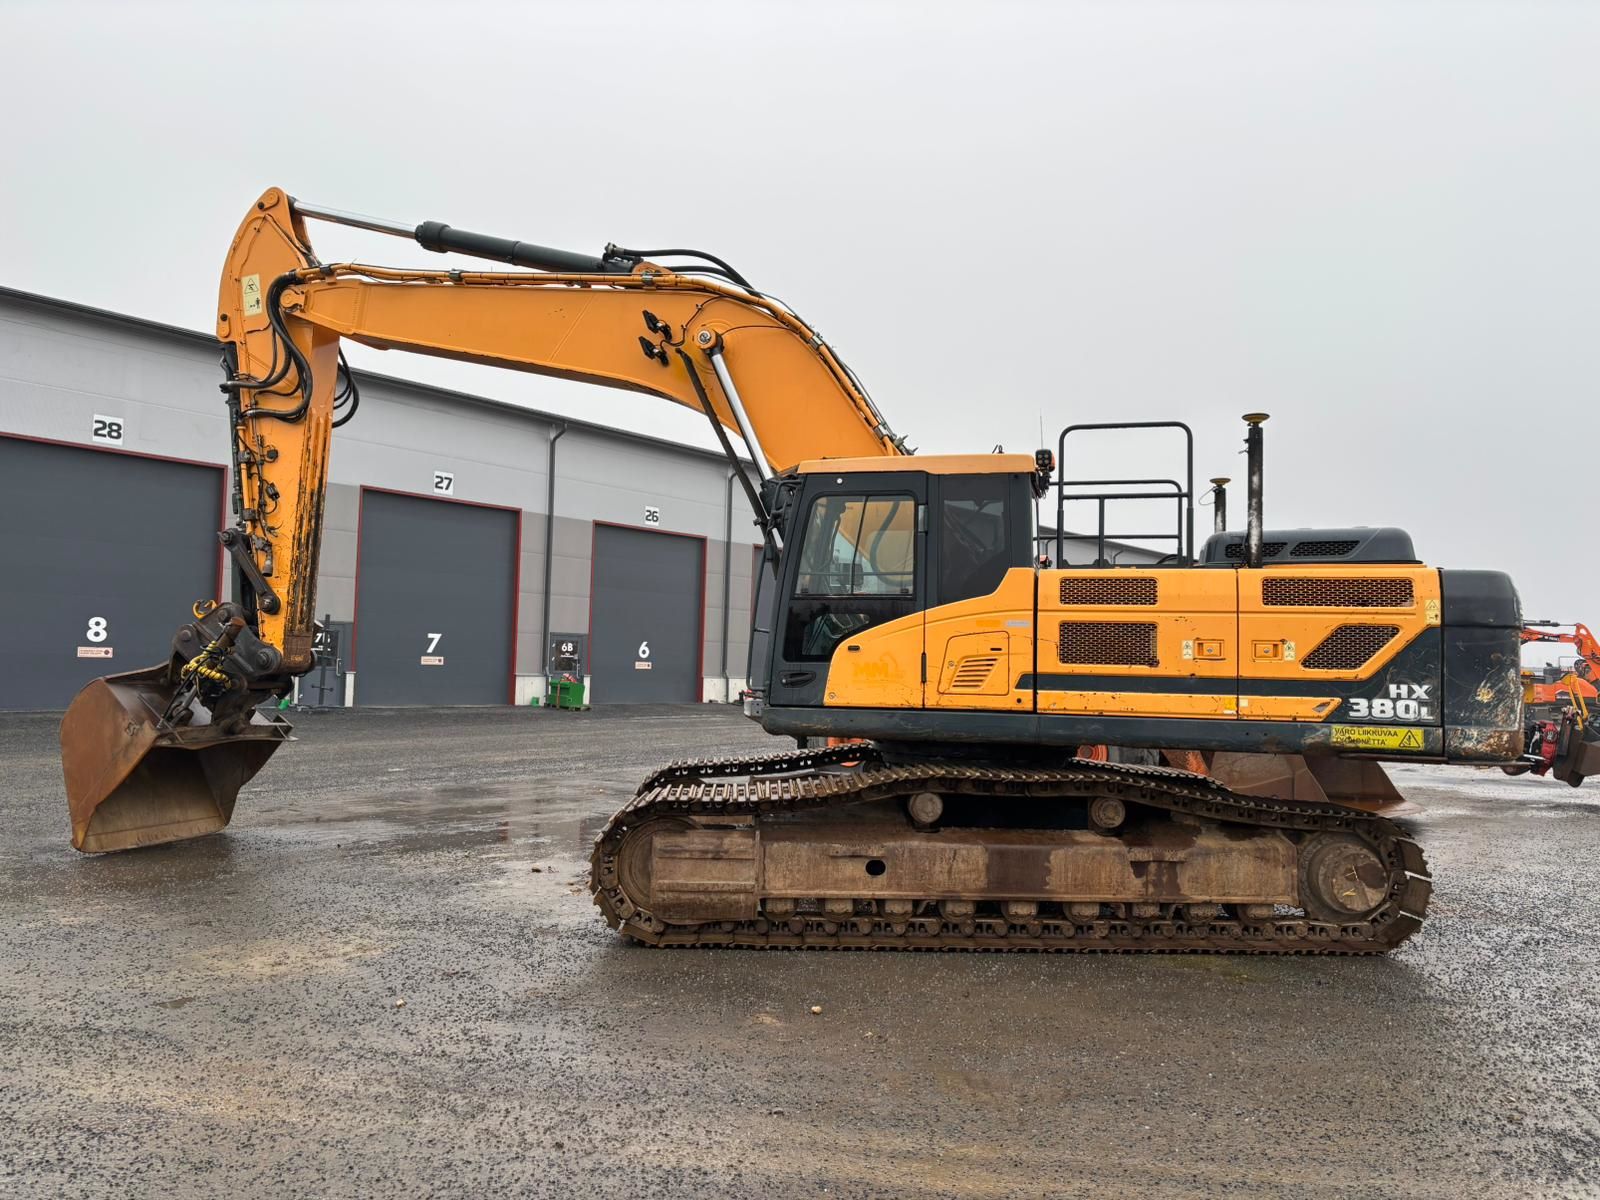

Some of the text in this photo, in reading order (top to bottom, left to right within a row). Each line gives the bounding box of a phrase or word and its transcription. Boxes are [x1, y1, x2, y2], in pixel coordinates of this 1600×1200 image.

[93, 419, 123, 440] 28
[434, 475, 453, 491] 27
[645, 509, 659, 523] 26
[86, 616, 108, 642] 8
[426, 633, 442, 653] 7
[561, 642, 574, 652] 6B
[638, 641, 650, 659] 6
[1388, 684, 1433, 699] HX
[1347, 698, 1435, 720] 380L
